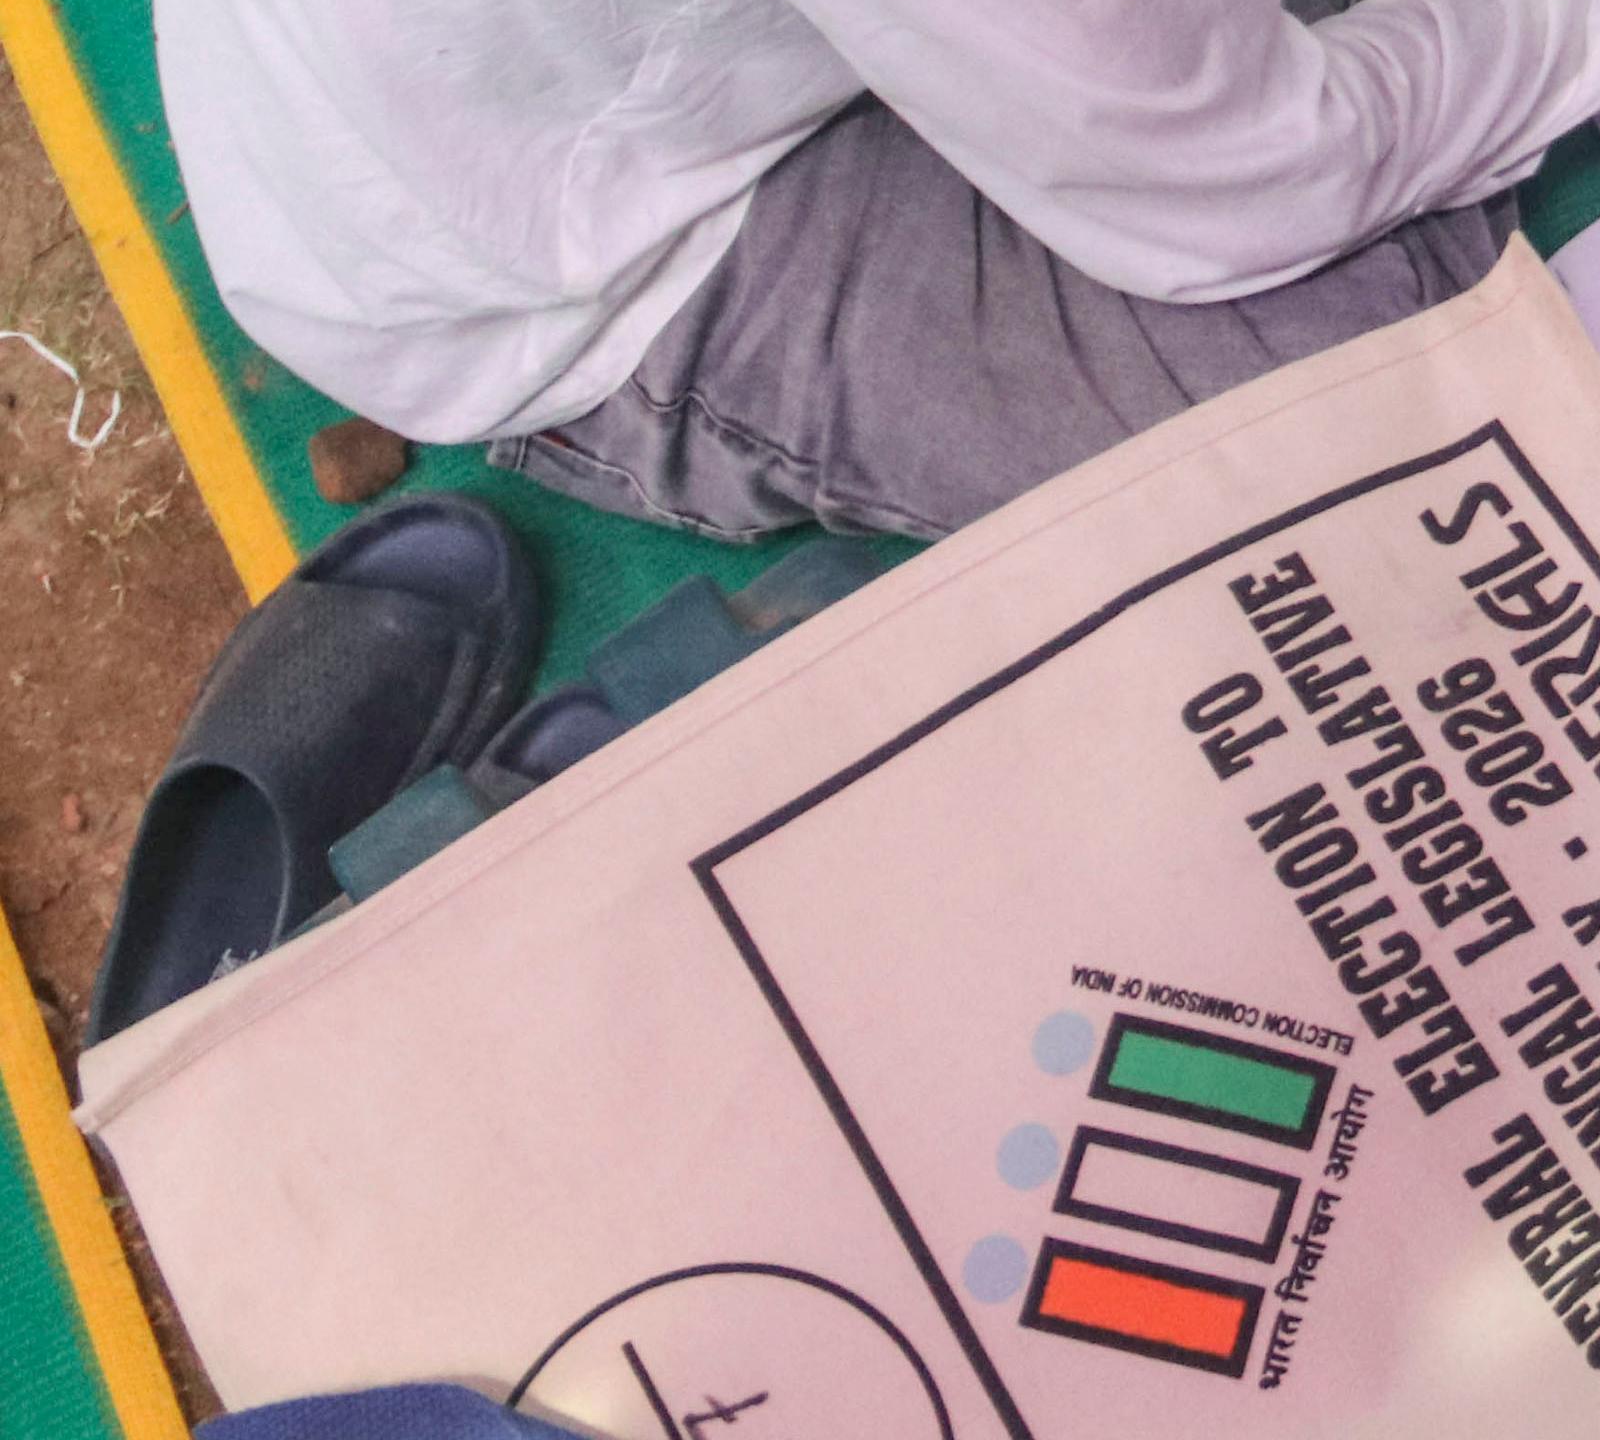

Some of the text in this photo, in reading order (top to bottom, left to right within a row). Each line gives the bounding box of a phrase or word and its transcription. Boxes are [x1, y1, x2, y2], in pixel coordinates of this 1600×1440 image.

[1182, 673, 1288, 781] TO
[1228, 552, 1535, 966] LEGISLATIVE
[1418, 658, 1573, 826] 2026
[1071, 965, 1354, 1056] ELECTION COMMISSION OF INDIA
[1245, 783, 1500, 1116] ELECTION
[1259, 1084, 1374, 1390] भारत निर्वाचन आयोग
